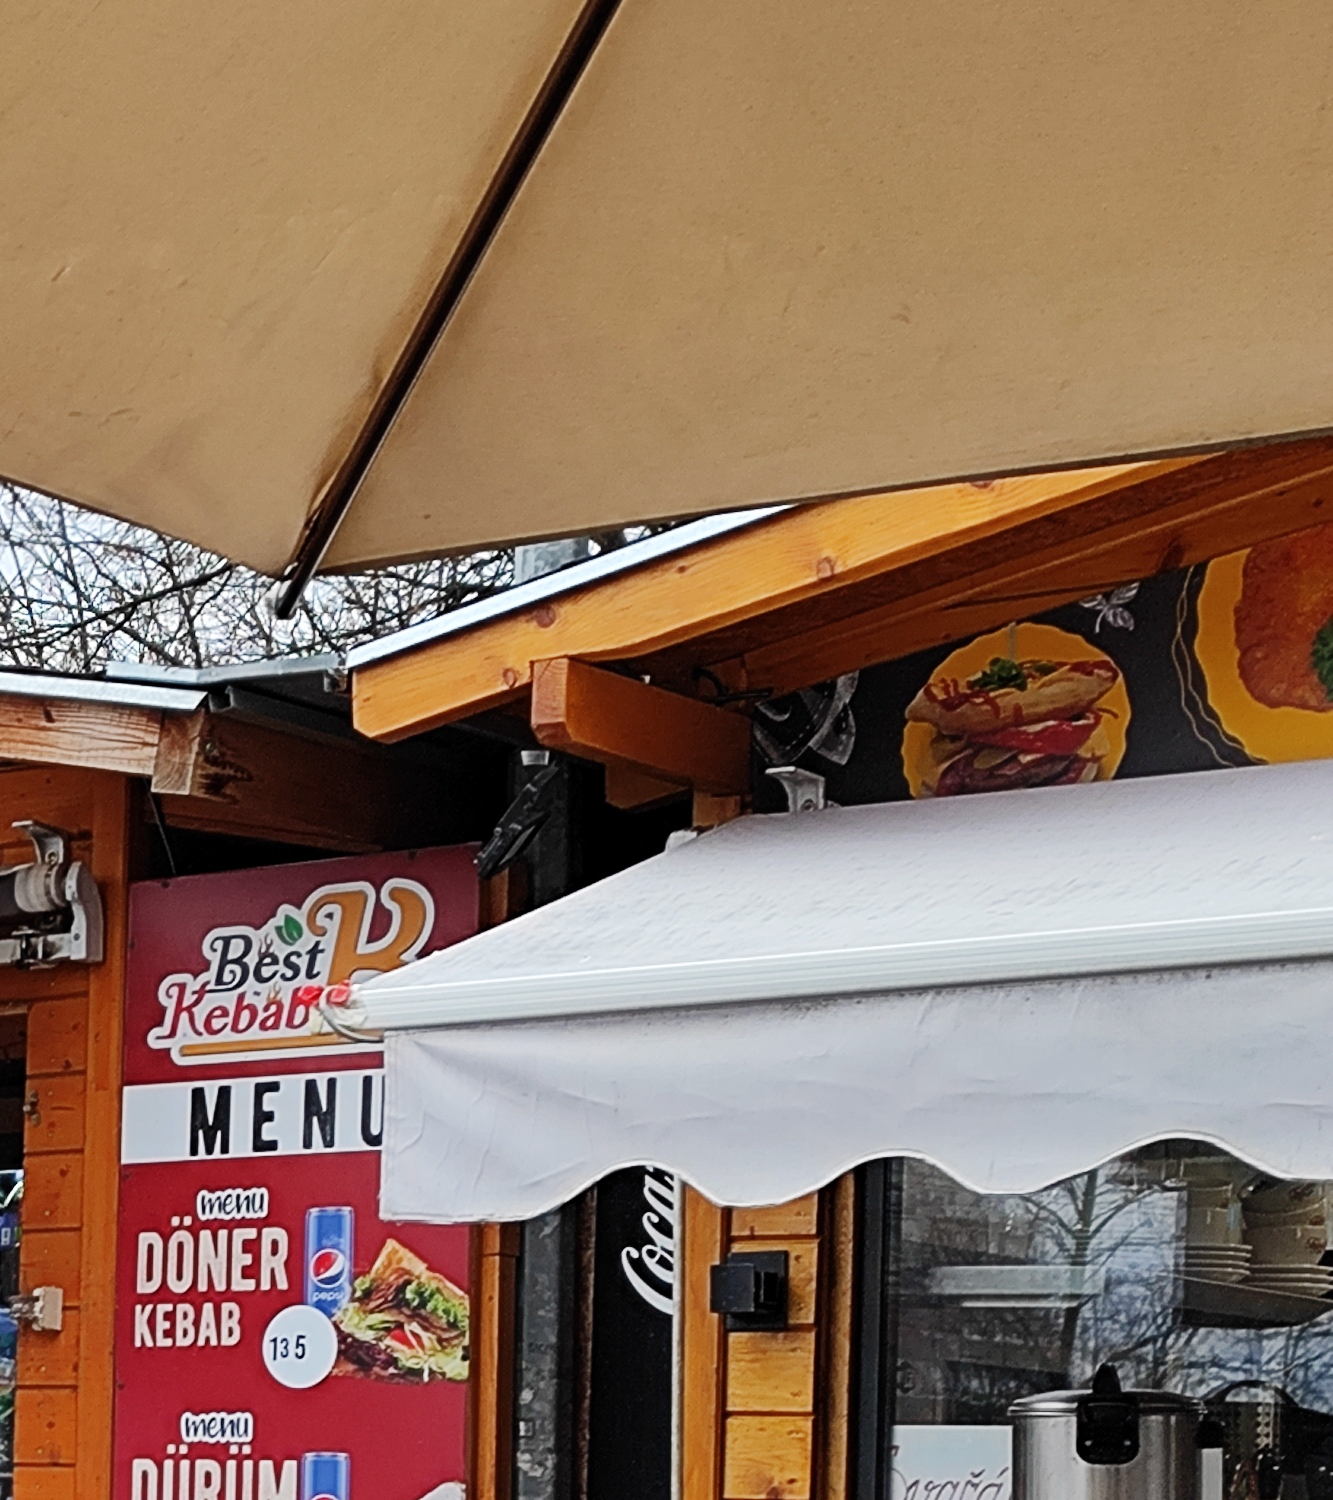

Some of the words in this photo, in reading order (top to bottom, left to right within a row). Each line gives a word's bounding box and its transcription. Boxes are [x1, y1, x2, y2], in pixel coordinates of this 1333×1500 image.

[210, 934, 325, 992] Best
[156, 982, 312, 1040] Kebab
[189, 1076, 385, 1157] MENU
[200, 1190, 264, 1218] menu
[136, 1216, 289, 1294] DÖNER
[134, 1302, 240, 1347] KEBAB
[184, 1413, 250, 1439] menu
